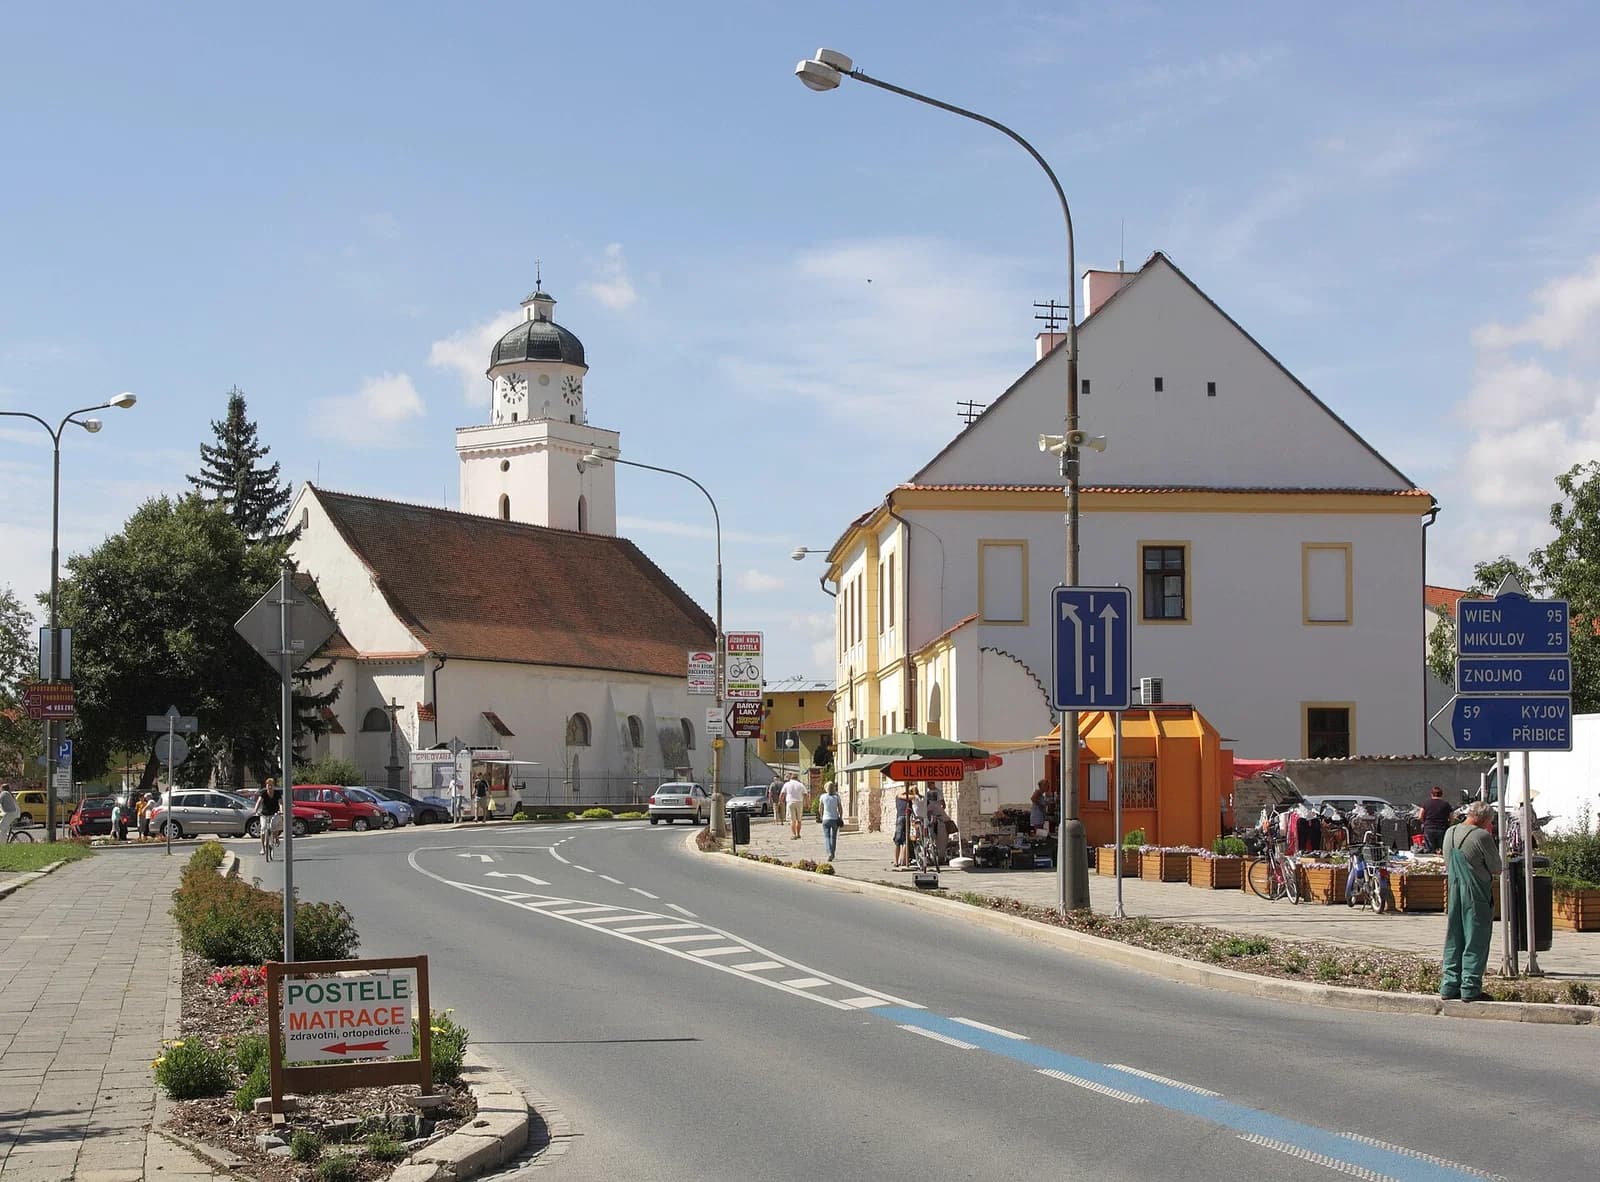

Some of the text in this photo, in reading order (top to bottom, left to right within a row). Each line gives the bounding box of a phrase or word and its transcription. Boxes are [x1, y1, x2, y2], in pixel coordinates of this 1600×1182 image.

[1465, 610, 1562, 623] WIEN 95
[1464, 632, 1563, 646] MIKULOV 25
[1464, 669, 1565, 682] ZNOJMO 40
[1463, 705, 1565, 719] 59 KYJOV
[1463, 724, 1566, 742] 5 PŘIBICE
[288, 979, 409, 1005] POSTELE
[288, 1006, 405, 1031] MATRACE
